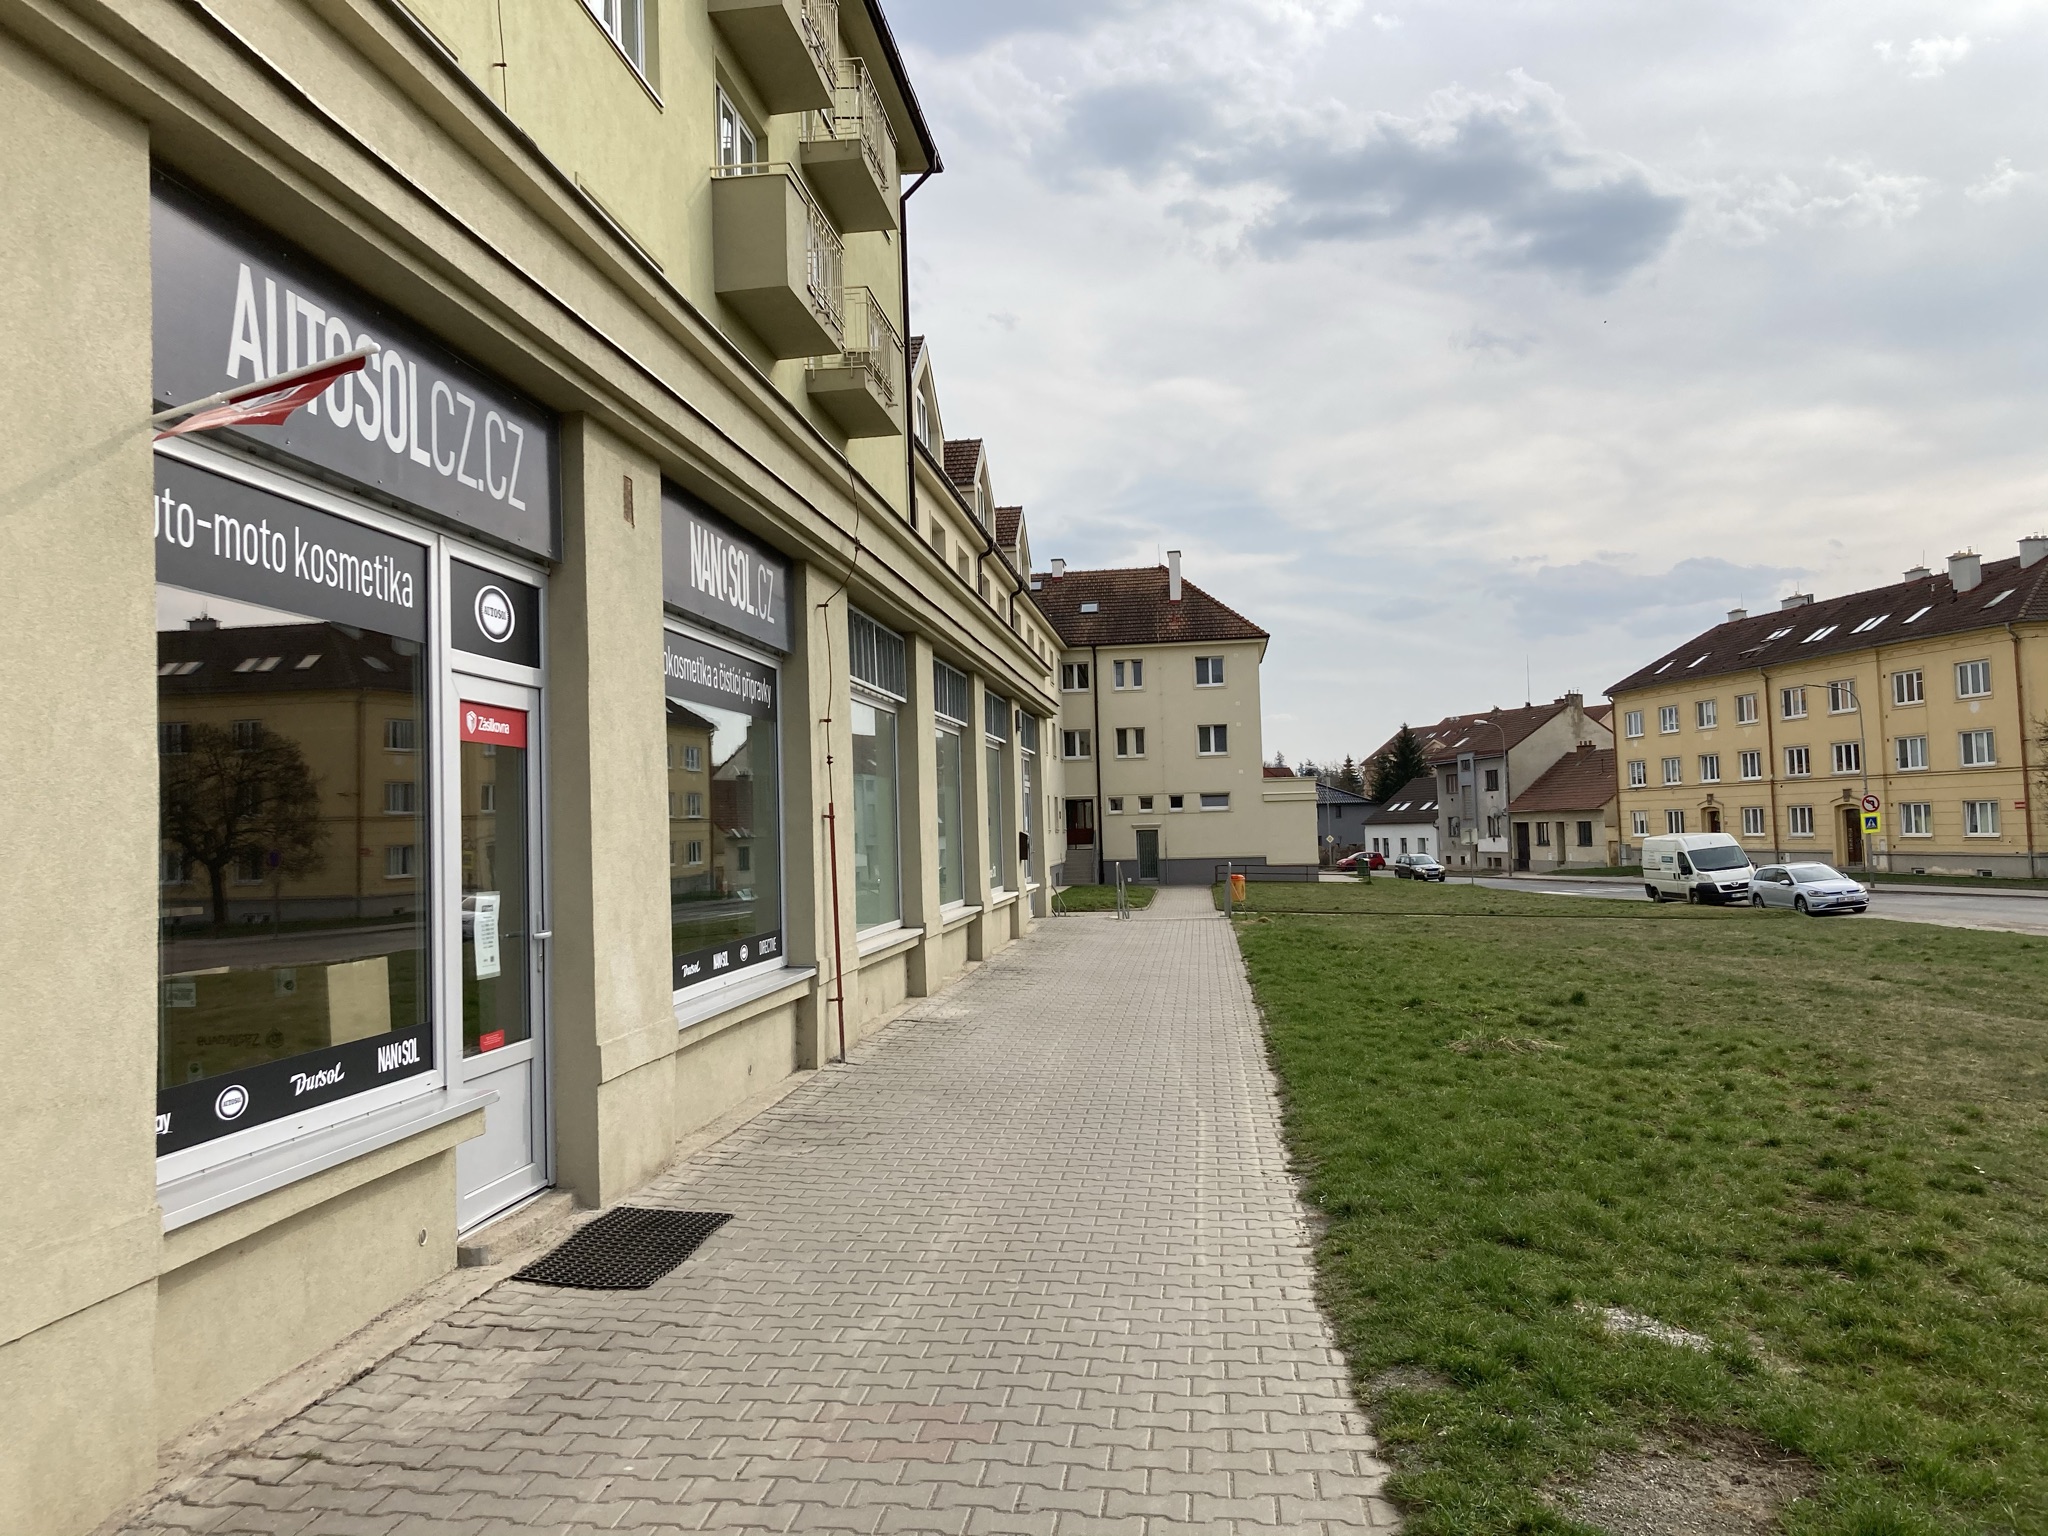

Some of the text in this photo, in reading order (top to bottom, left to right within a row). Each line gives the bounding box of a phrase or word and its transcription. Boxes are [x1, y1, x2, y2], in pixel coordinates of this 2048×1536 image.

[294, 526, 414, 609] kosmetika
[713, 667, 718, 689] a
[719, 662, 741, 696] čistící
[742, 671, 772, 709] přípravky
